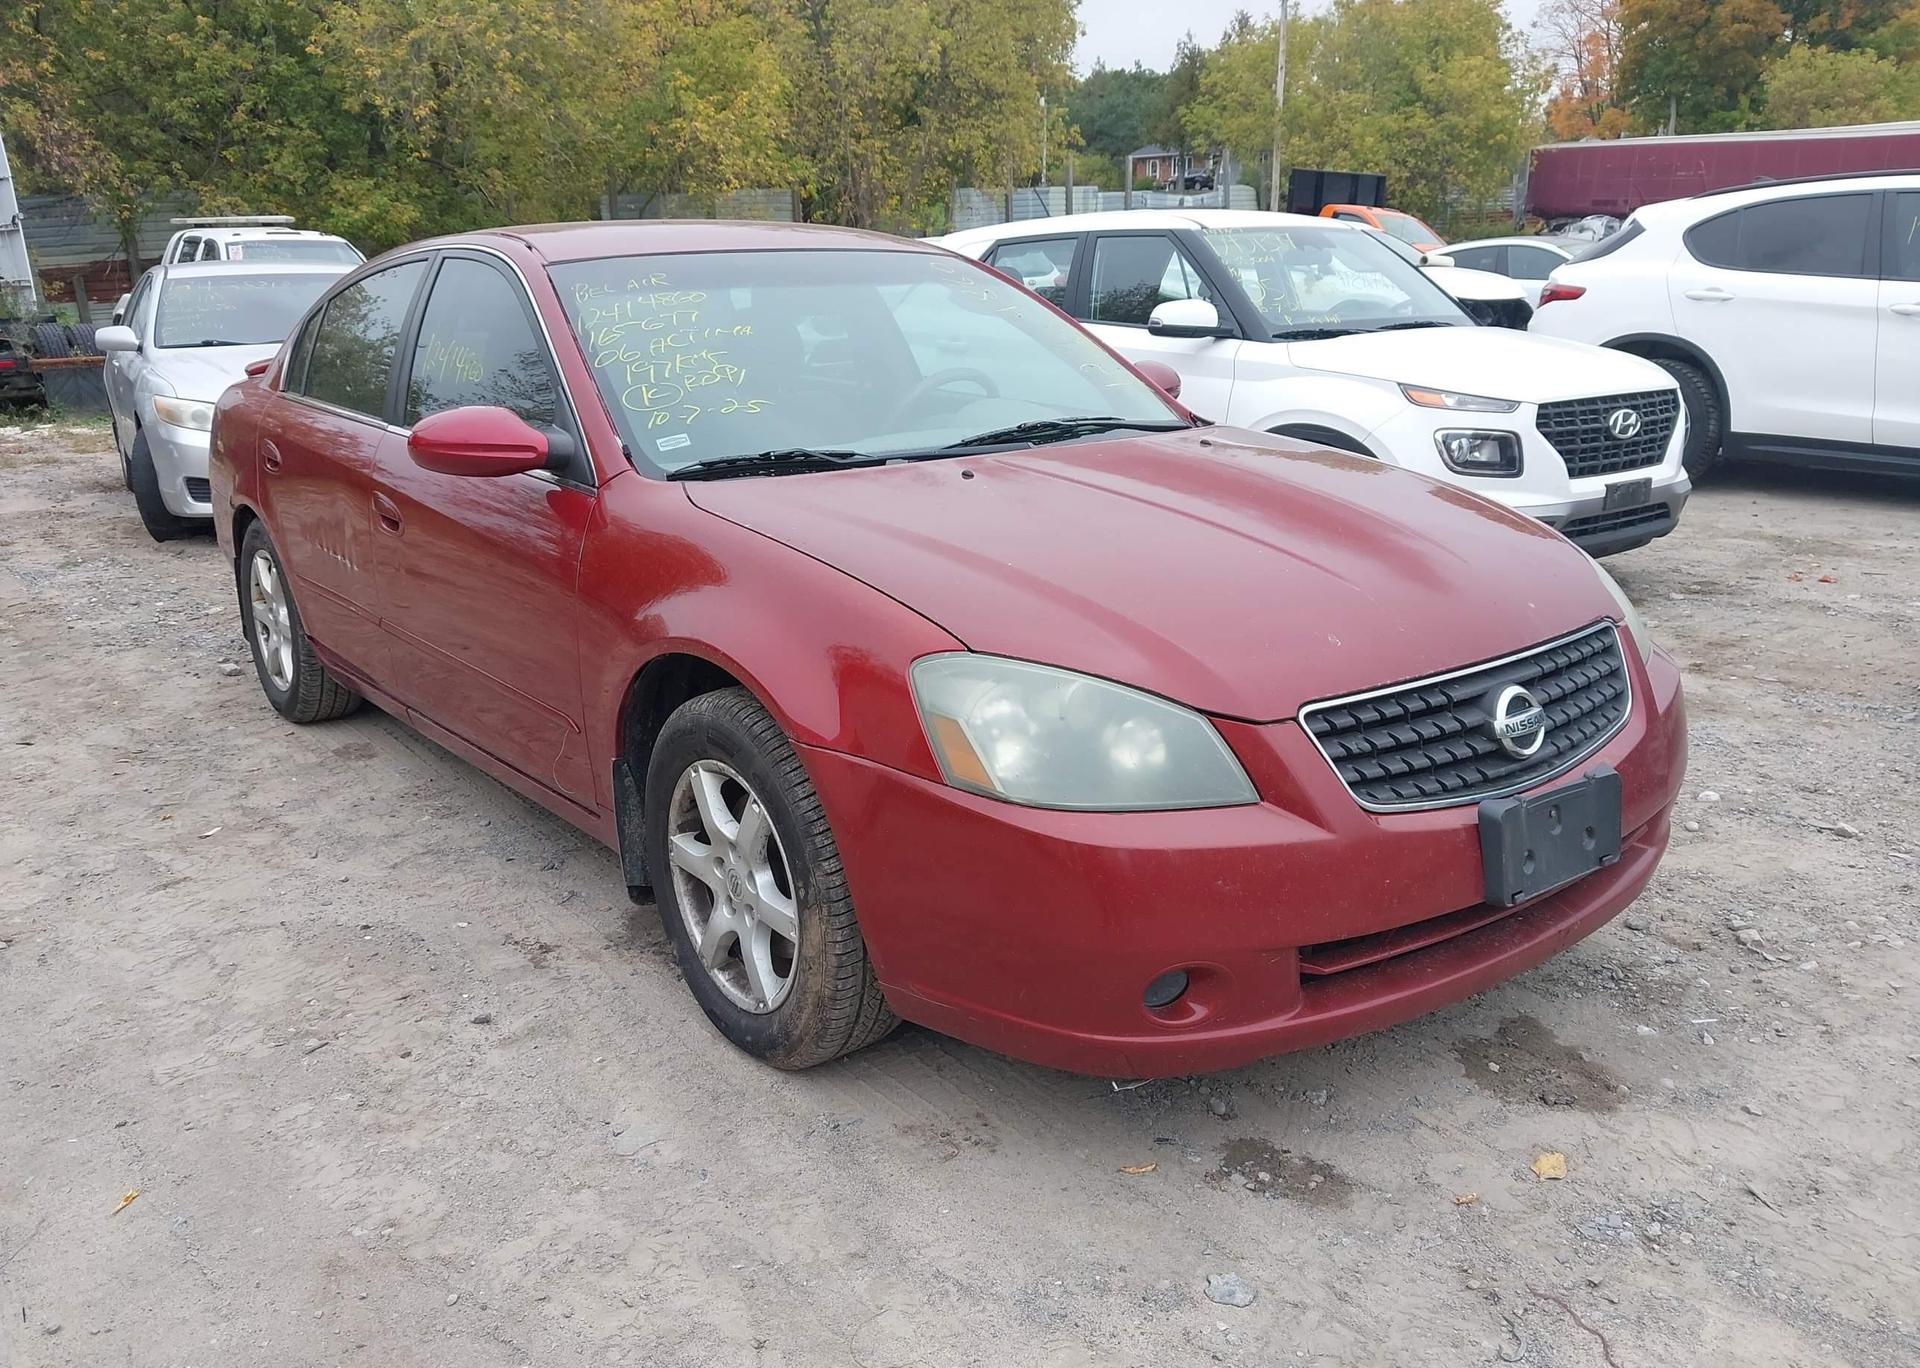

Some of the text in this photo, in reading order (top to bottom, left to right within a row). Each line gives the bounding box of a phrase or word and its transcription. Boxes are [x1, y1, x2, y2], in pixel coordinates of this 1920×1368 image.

[573, 282, 616, 303] BEL
[594, 344, 641, 368] 06
[1505, 711, 1545, 734] NISSAN
